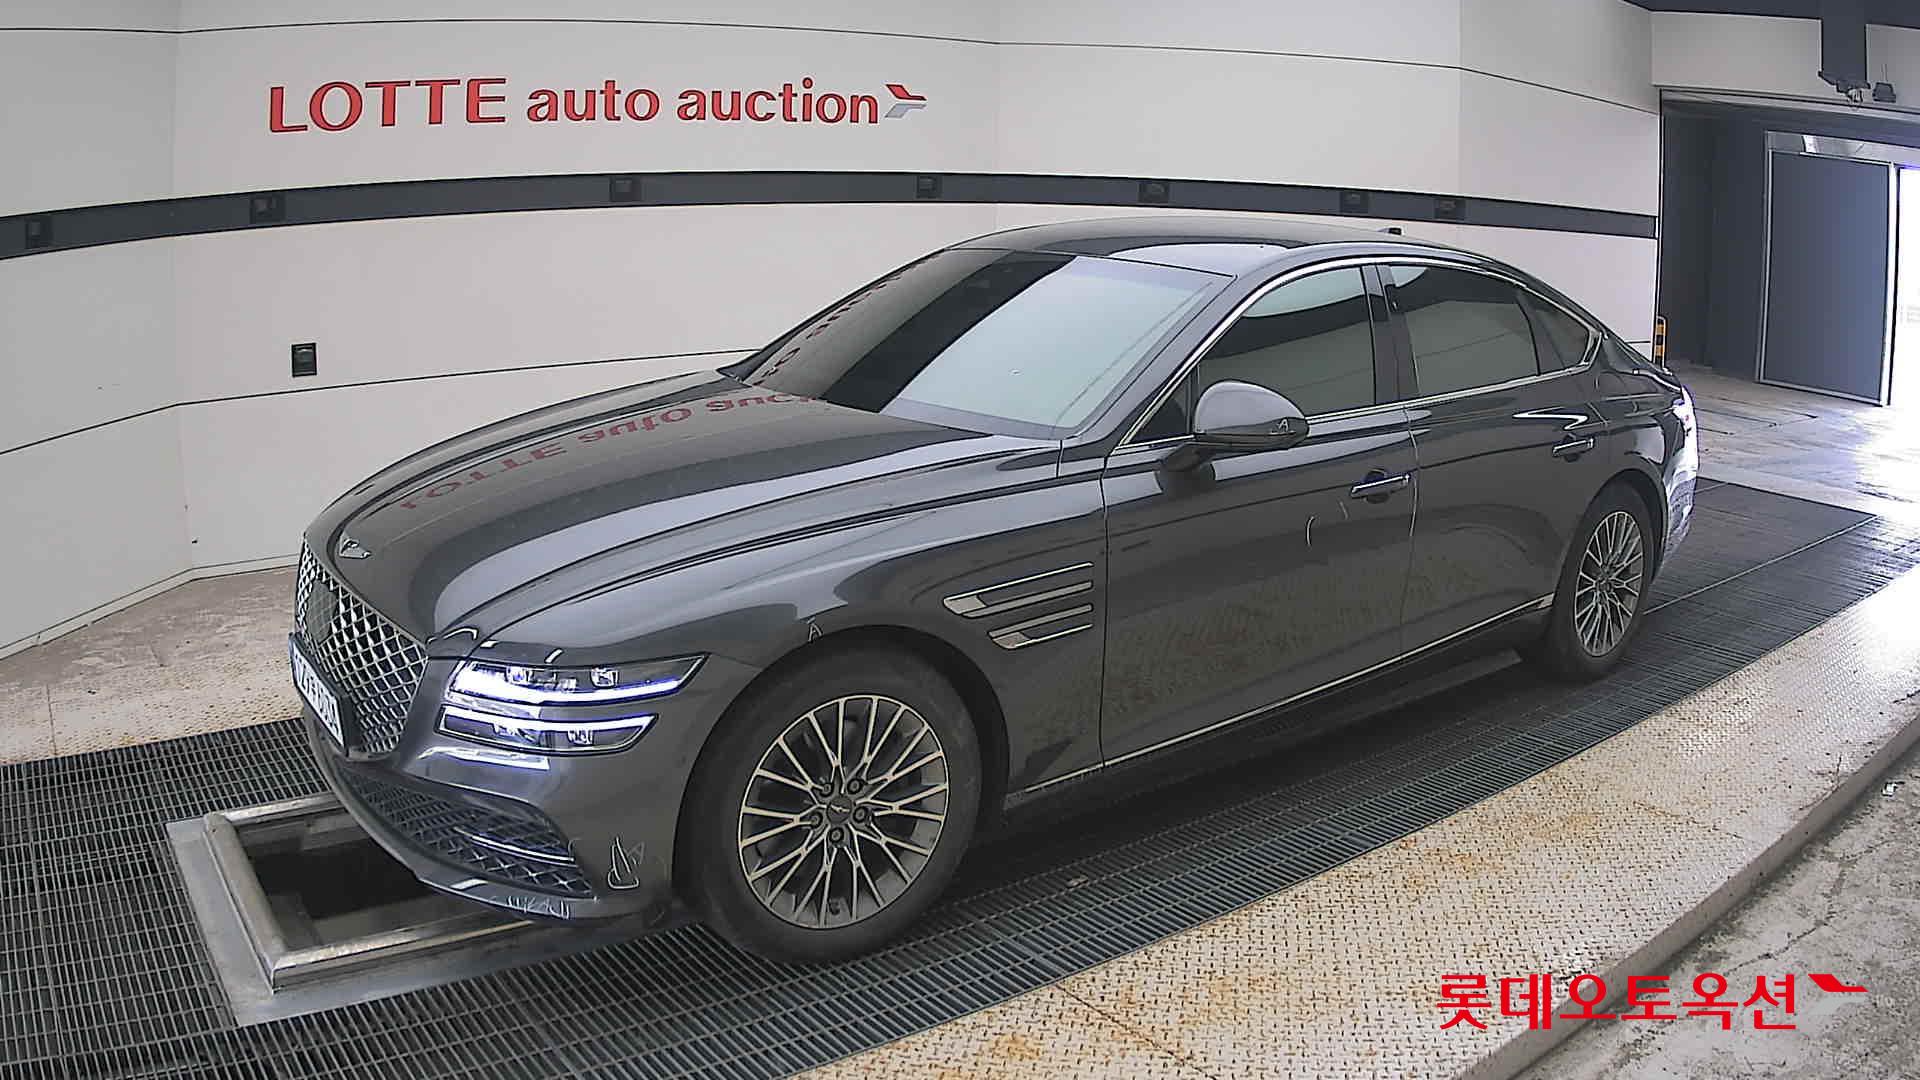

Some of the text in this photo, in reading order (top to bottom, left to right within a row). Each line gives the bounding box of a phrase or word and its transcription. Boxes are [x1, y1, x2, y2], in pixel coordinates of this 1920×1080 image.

[268, 77, 879, 133] LOTTE auto auction
